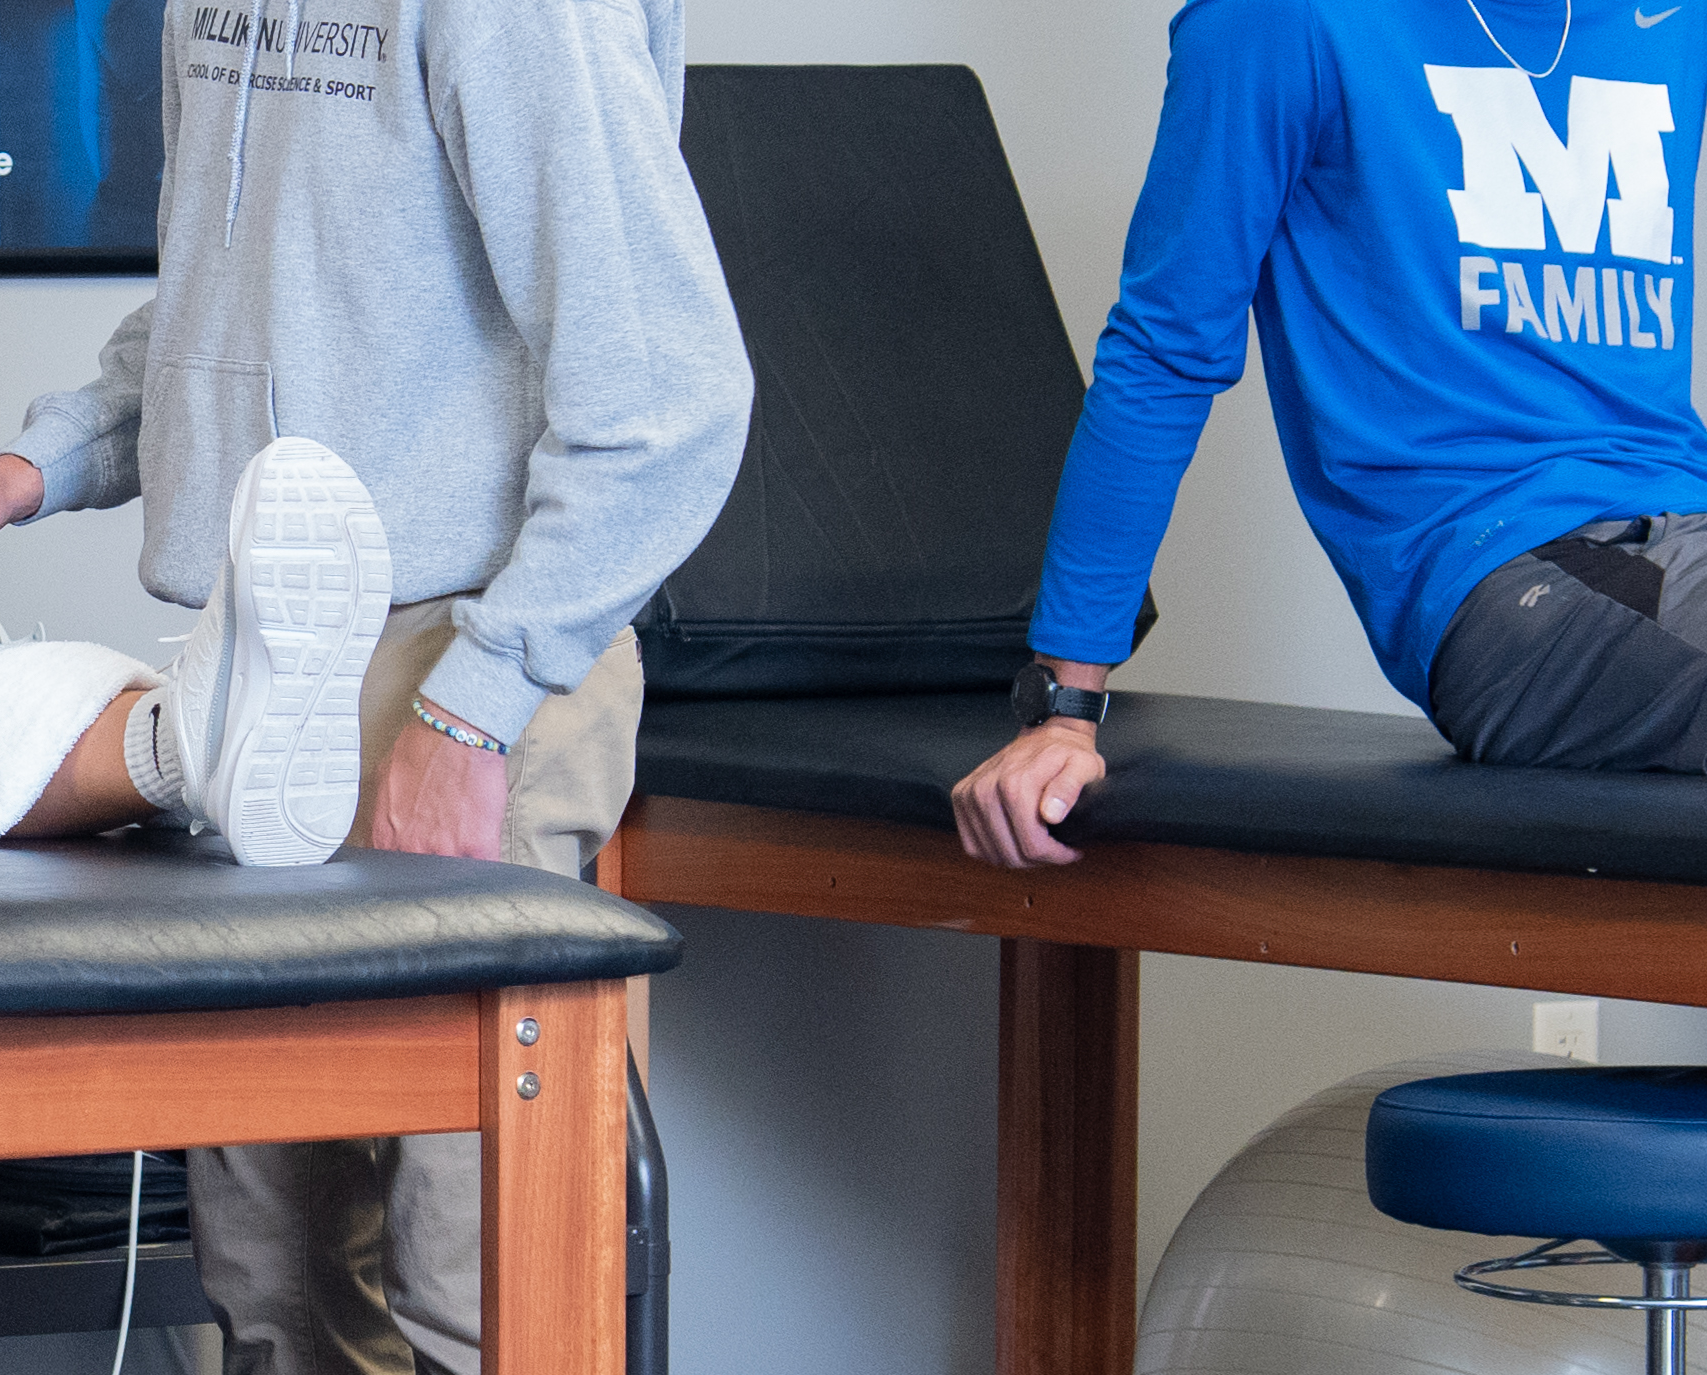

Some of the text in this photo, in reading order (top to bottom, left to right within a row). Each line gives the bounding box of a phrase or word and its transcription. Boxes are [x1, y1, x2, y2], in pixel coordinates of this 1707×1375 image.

[211, 65, 226, 82] OF
[325, 80, 377, 102] SPORT
[1423, 64, 1676, 265] M
[1459, 255, 1674, 350] FAMILY
